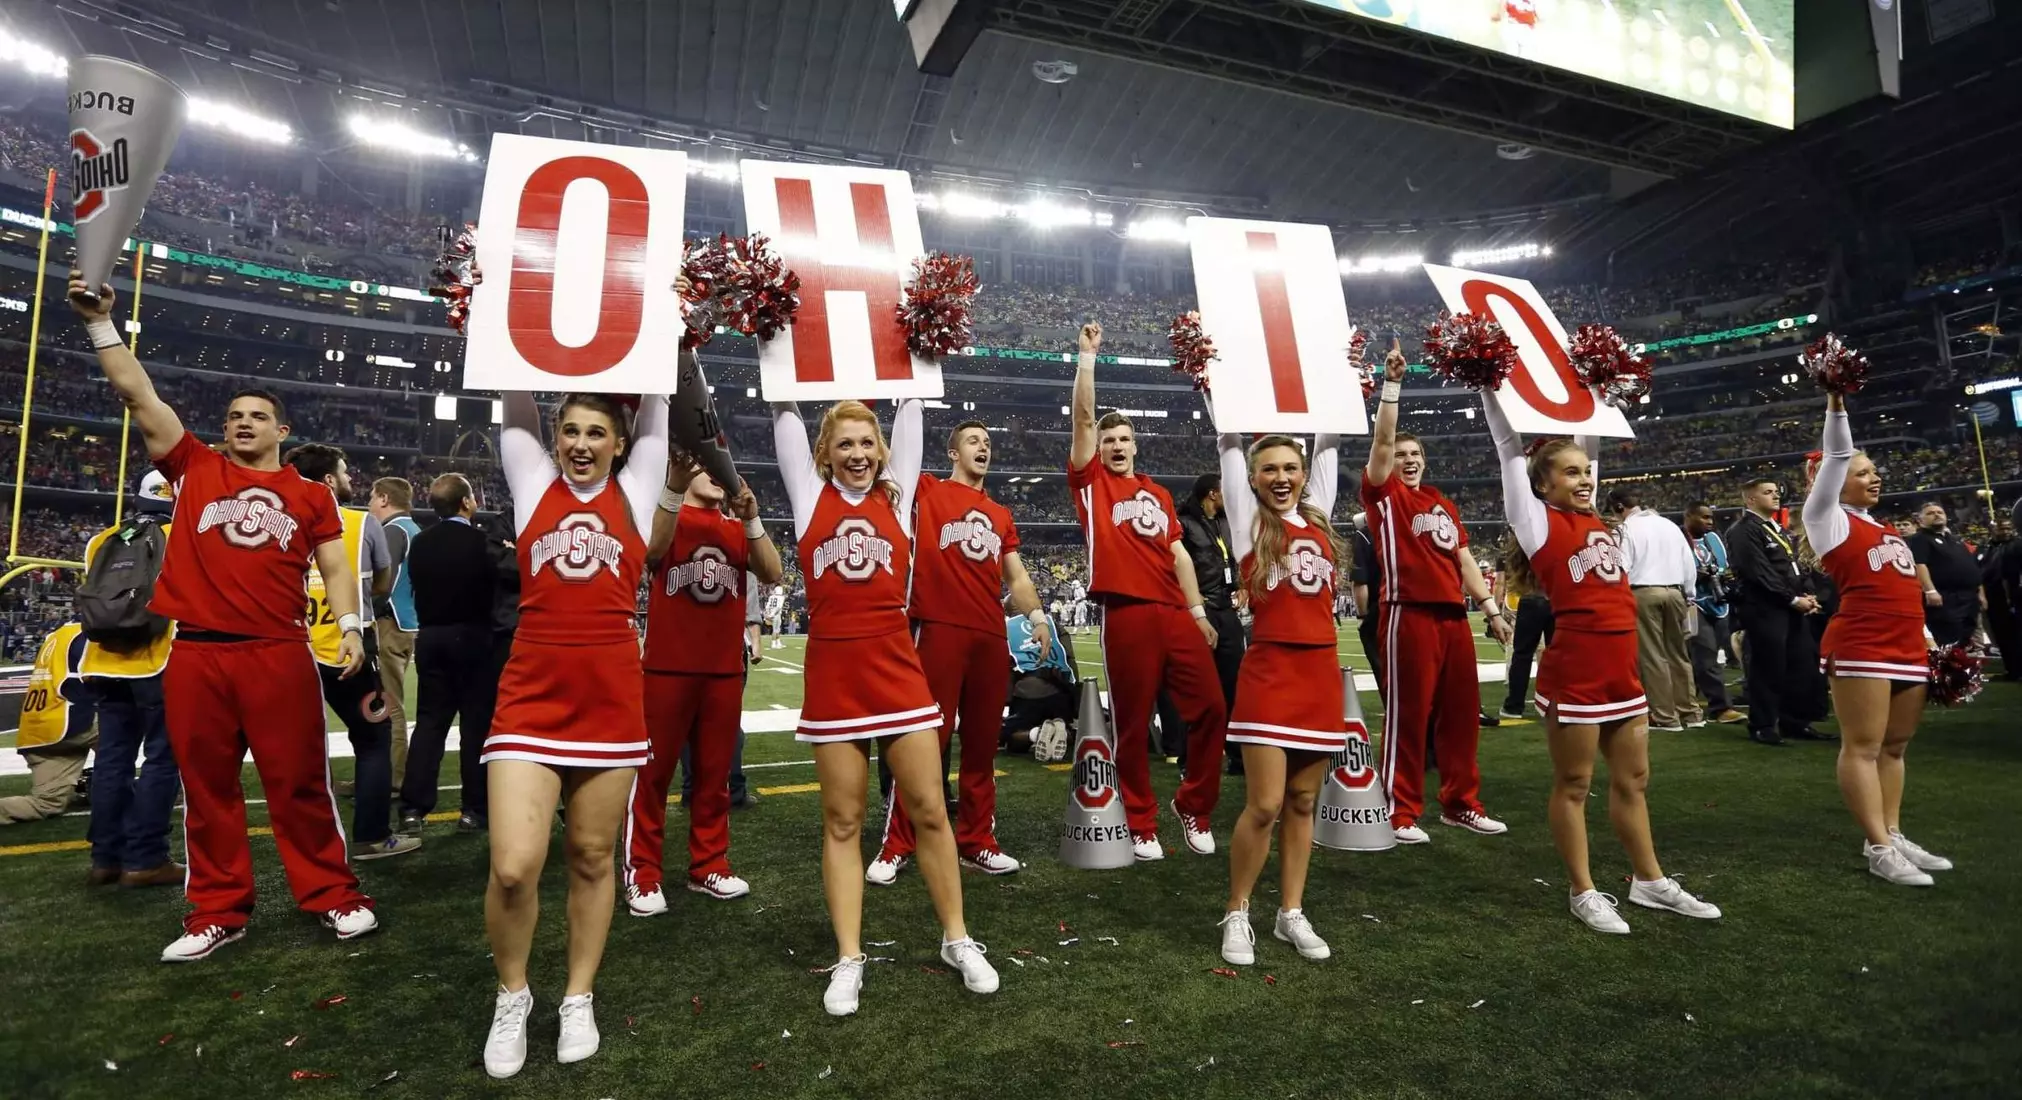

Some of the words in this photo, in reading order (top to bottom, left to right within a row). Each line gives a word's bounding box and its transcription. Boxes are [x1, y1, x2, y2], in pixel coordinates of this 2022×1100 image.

[80, 137, 129, 192] OHIO
[197, 500, 249, 533] OHIO
[241, 501, 298, 552] STATE
[1112, 500, 1143, 527] OHIO
[531, 530, 571, 577] OHIO
[570, 526, 624, 578] STATE
[813, 535, 849, 579] OHIO
[849, 531, 893, 576] STATE
[940, 521, 974, 549] OHIO
[666, 561, 703, 596] OHIO
[702, 558, 739, 600] STATE
[1568, 545, 1601, 583] OHIO
[1321, 805, 1391, 824] BUCKEYE
